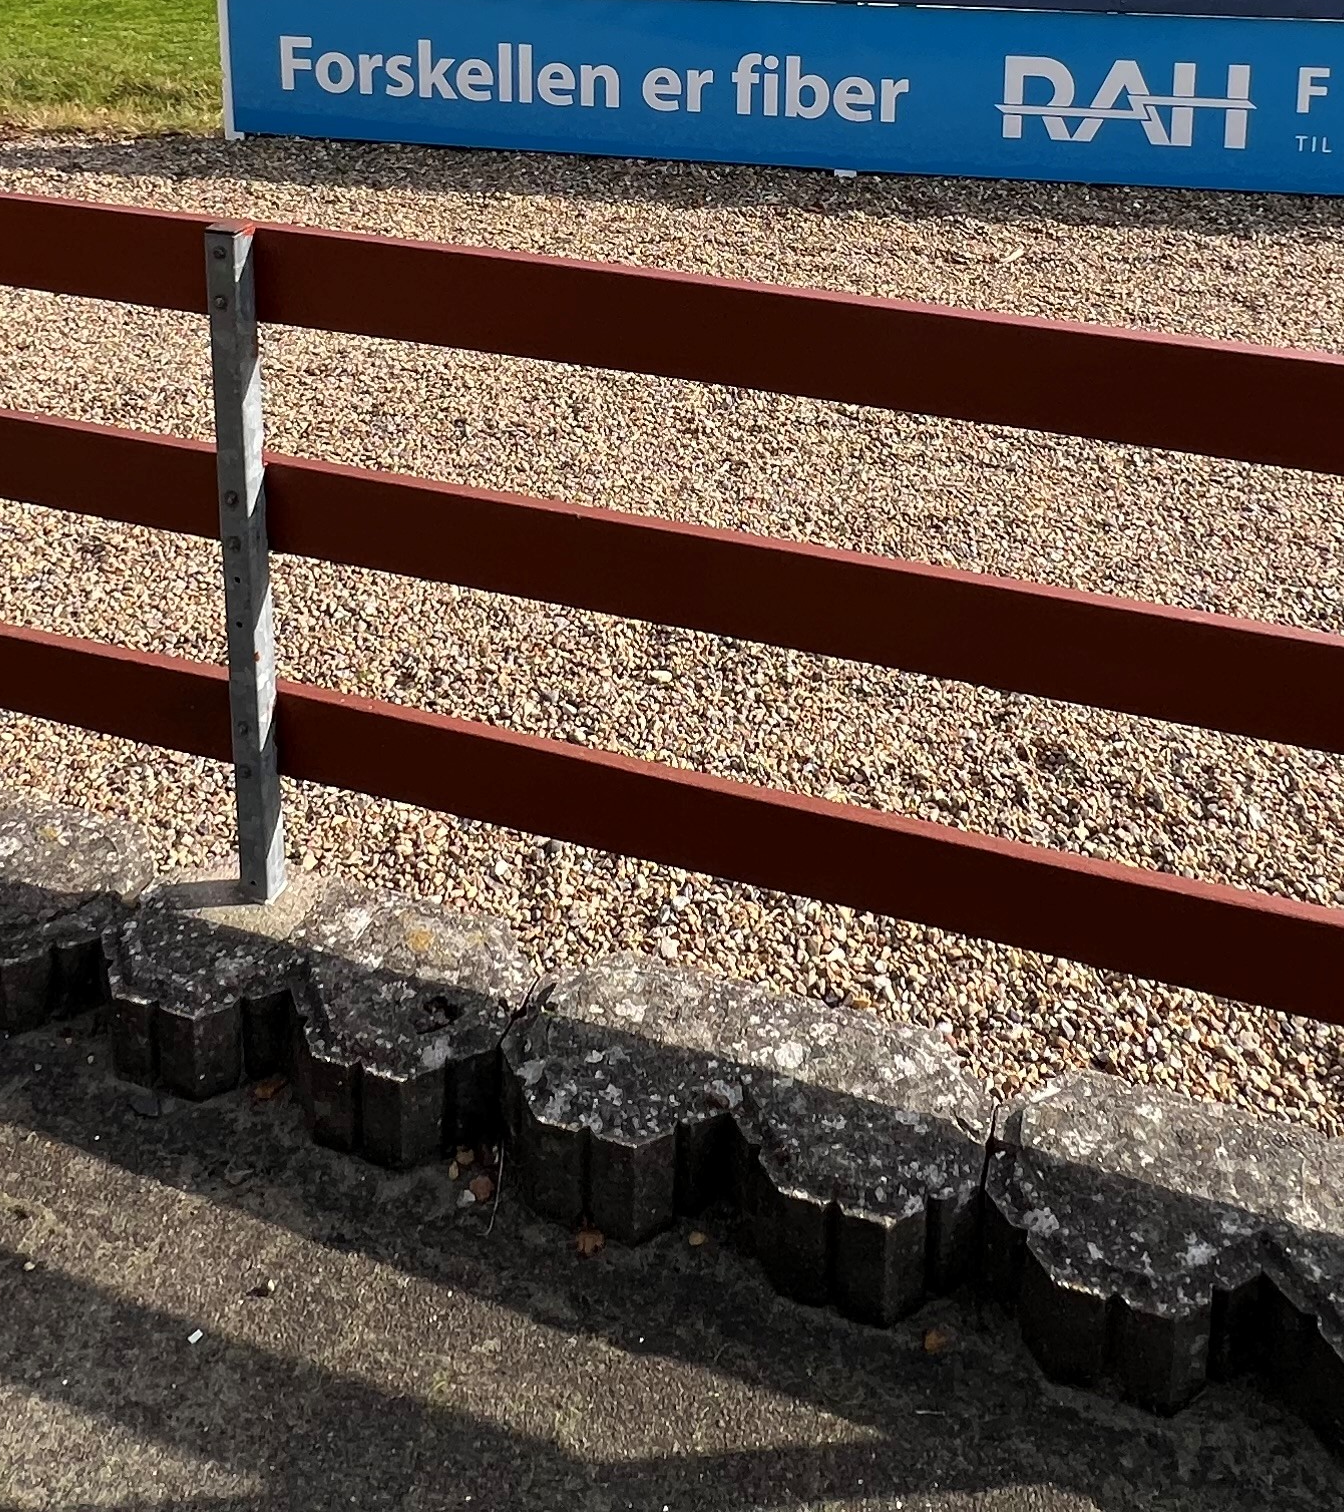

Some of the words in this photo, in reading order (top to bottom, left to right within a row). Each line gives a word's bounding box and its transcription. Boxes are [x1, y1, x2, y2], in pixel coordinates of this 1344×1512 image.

[279, 35, 621, 109] Forskellen
[642, 66, 714, 112] er
[731, 52, 910, 123] fiber
[994, 54, 1258, 150] RAH
[1295, 135, 1333, 153] TIL
